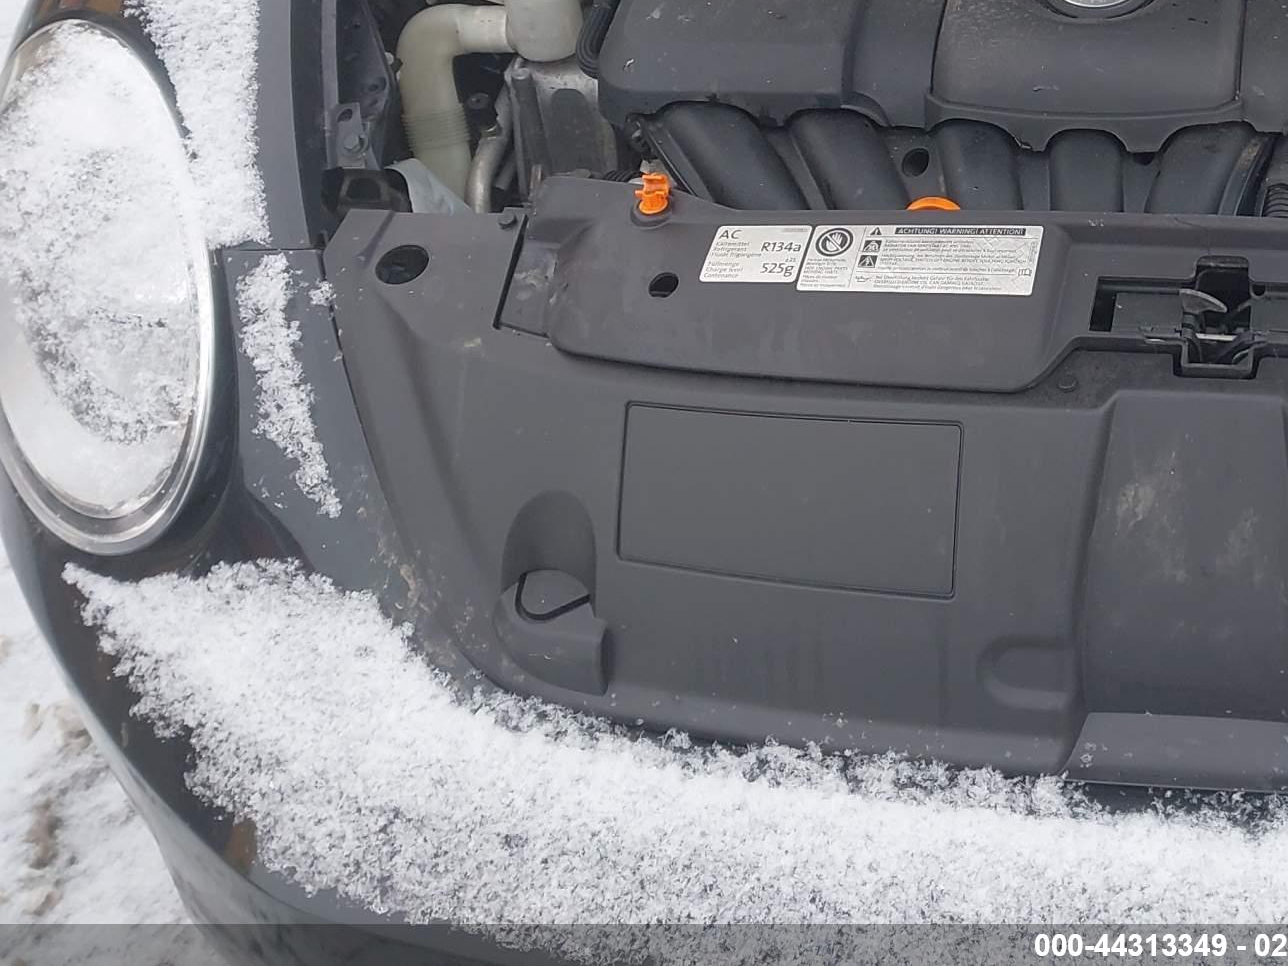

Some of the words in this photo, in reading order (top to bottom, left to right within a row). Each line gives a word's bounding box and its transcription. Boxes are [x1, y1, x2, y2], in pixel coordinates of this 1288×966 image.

[719, 229, 742, 240] AC
[898, 227, 938, 235] ACHTUNG!
[979, 228, 1024, 236] ATTENTION!
[761, 241, 802, 253] R134a
[760, 262, 795, 278] 525g
